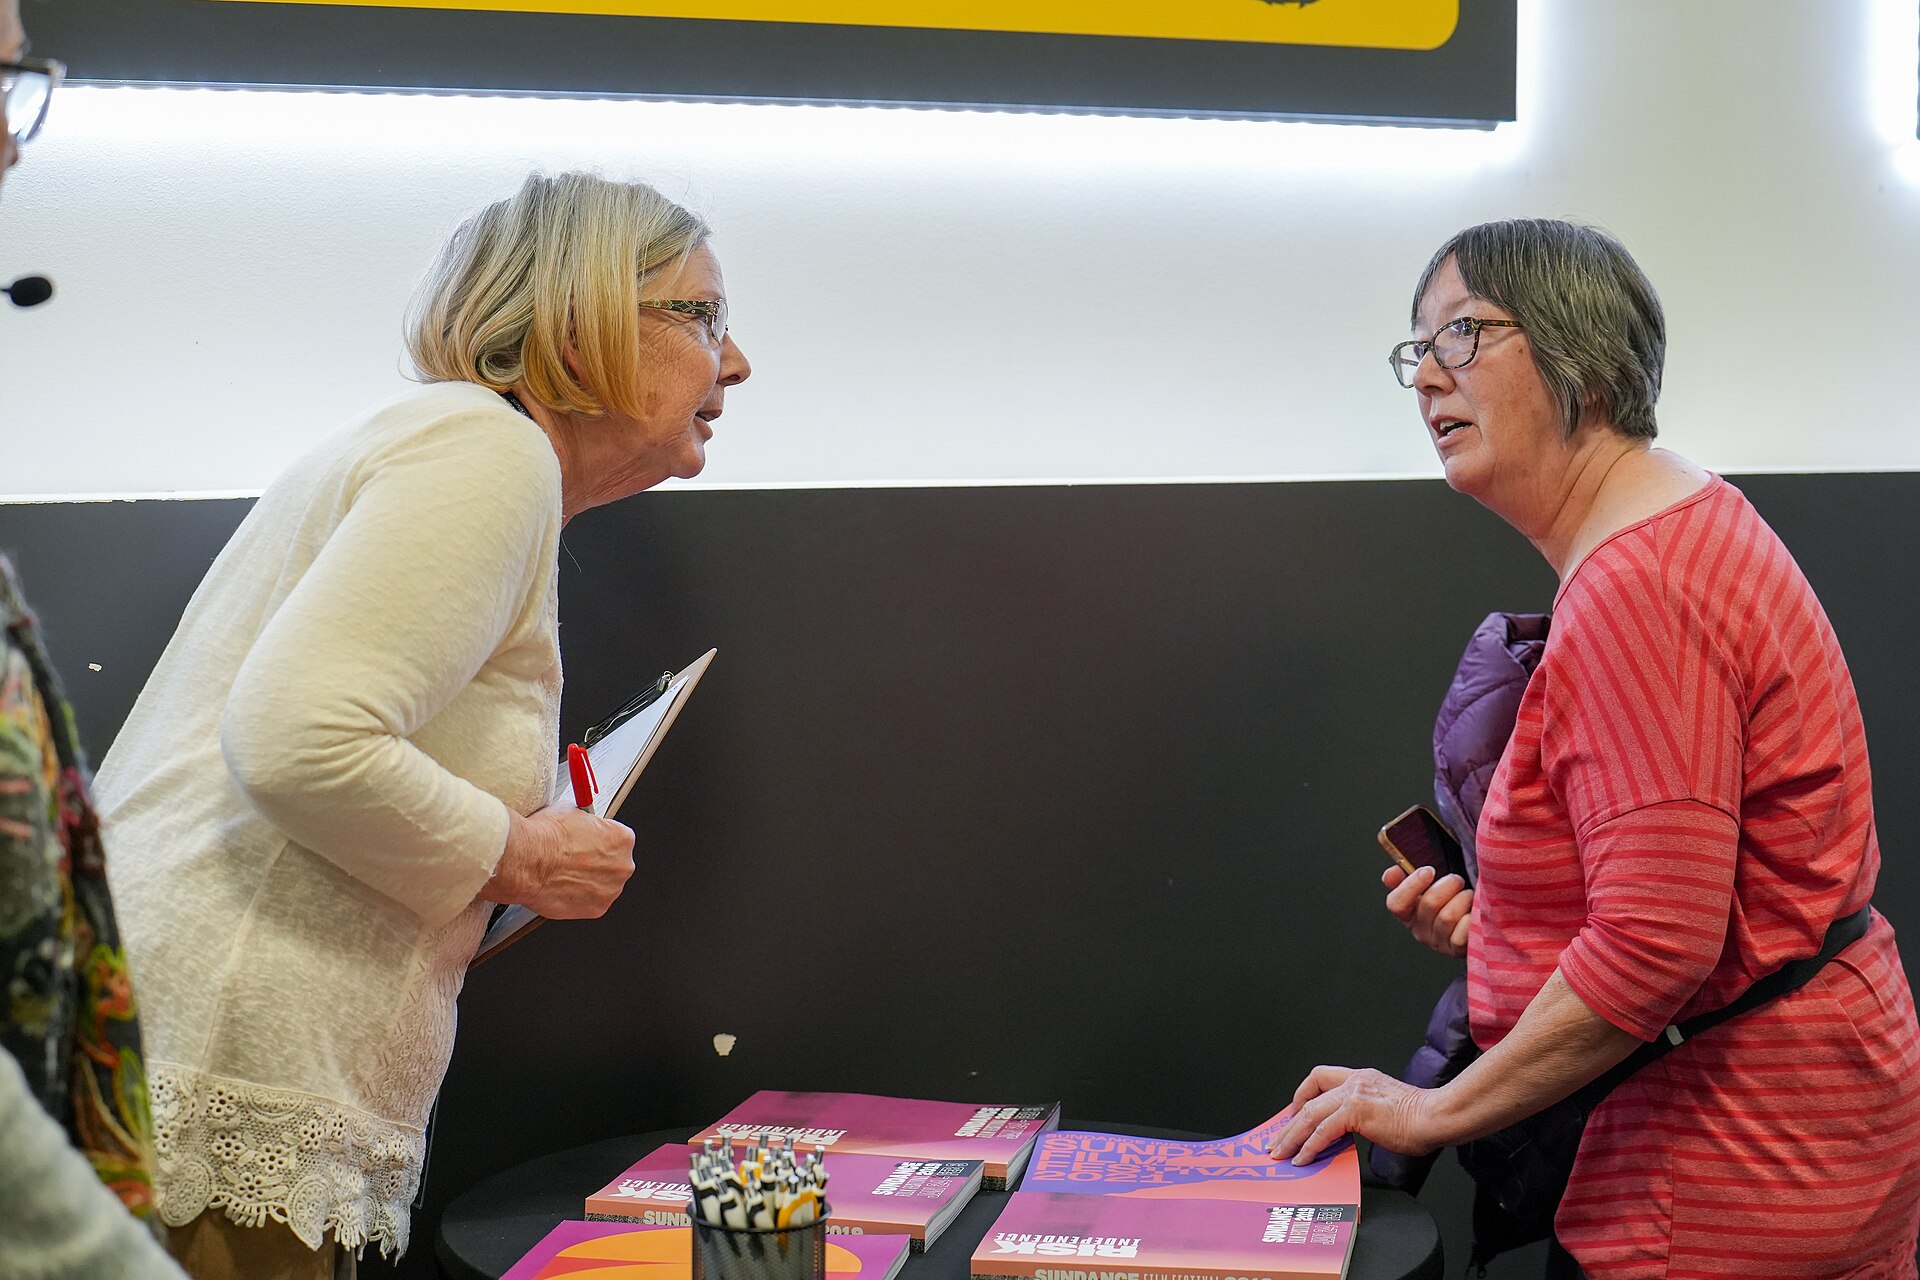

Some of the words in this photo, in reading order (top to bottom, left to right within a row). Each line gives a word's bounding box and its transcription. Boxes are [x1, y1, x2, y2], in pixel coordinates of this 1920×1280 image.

[718, 1123, 847, 1137] INDEPENDENCE
[1045, 1133, 1147, 1145] SUNDANCE
[1249, 1114, 1293, 1142] PRES
[1043, 1137, 1270, 1158] SUNDAN
[1039, 1149, 1169, 1166] FILM
[1036, 1160, 1296, 1177] FESTIVAL
[618, 1178, 693, 1192] NDENCE
[871, 1161, 924, 1196] SUNDANCE
[1032, 1171, 1174, 1184] 2021
[608, 1186, 693, 1202] SK
[643, 1210, 693, 1227] SUND
[1294, 1207, 1316, 1221] 2019
[1261, 1206, 1295, 1243] SUNDANCE
[993, 1232, 1142, 1247] INDEPENDENCE
[989, 1240, 1138, 1258] RISK
